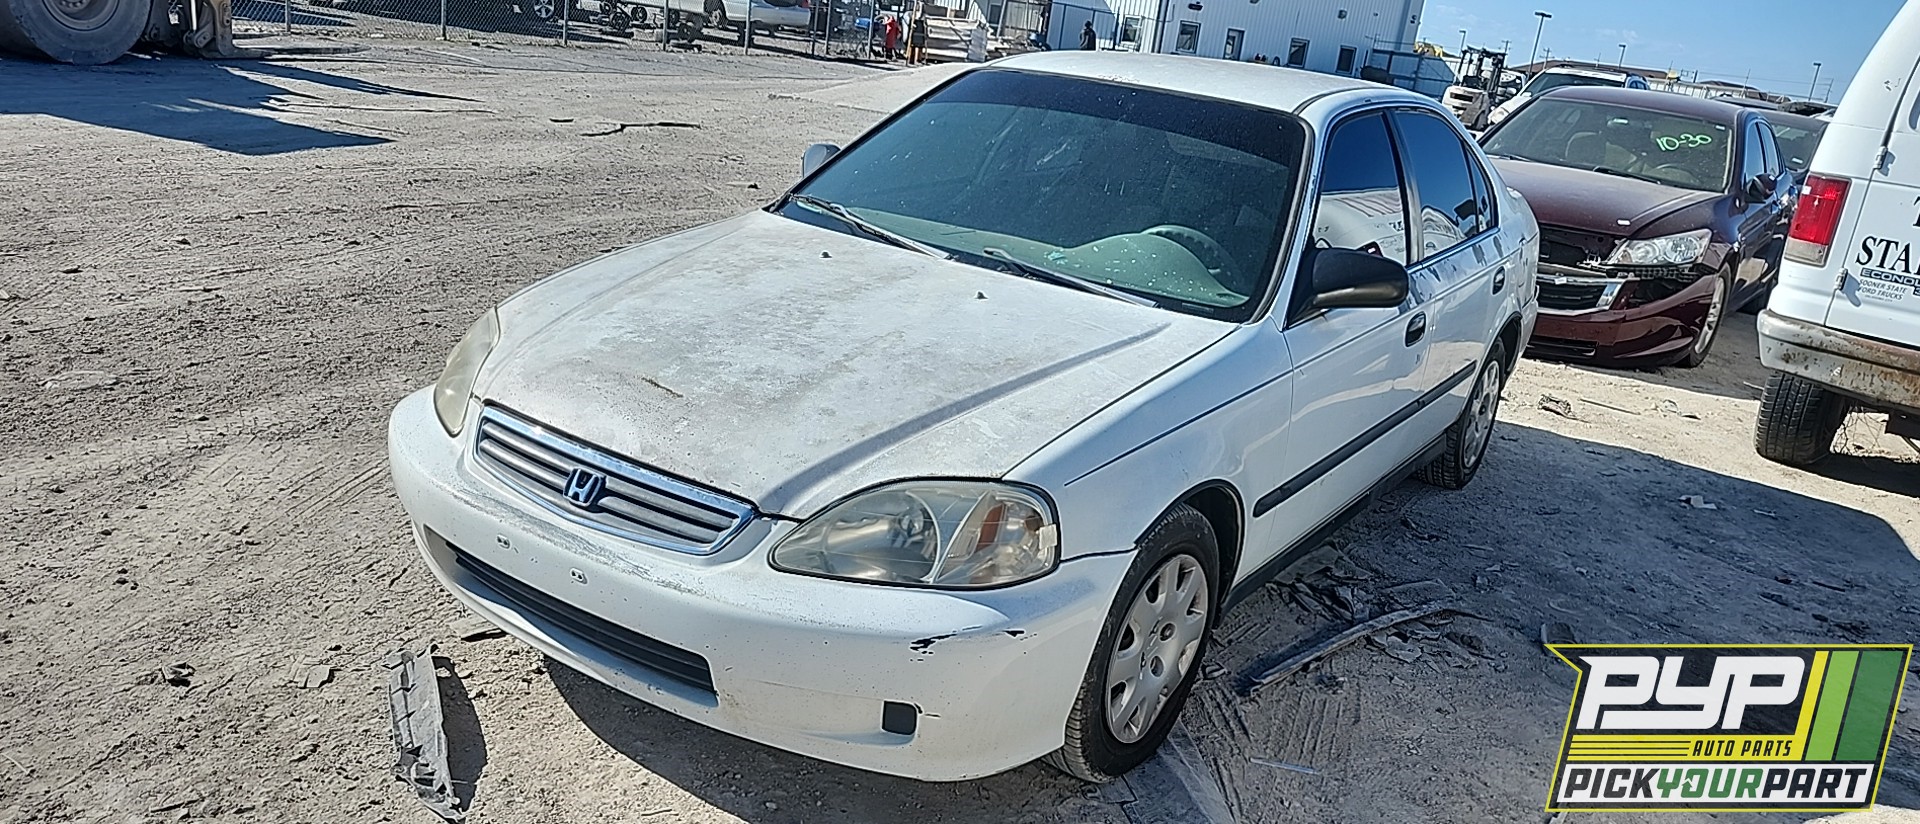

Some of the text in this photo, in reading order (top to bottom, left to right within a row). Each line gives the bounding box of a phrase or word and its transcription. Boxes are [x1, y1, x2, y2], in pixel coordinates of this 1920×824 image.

[1656, 134, 1712, 151] 10-30
[1855, 236, 1920, 275] STA
[1858, 286, 1877, 295] FORD
[1877, 290, 1903, 301] TRUCKS
[1860, 279, 1886, 289] SOONER
[1886, 284, 1907, 294] STATE
